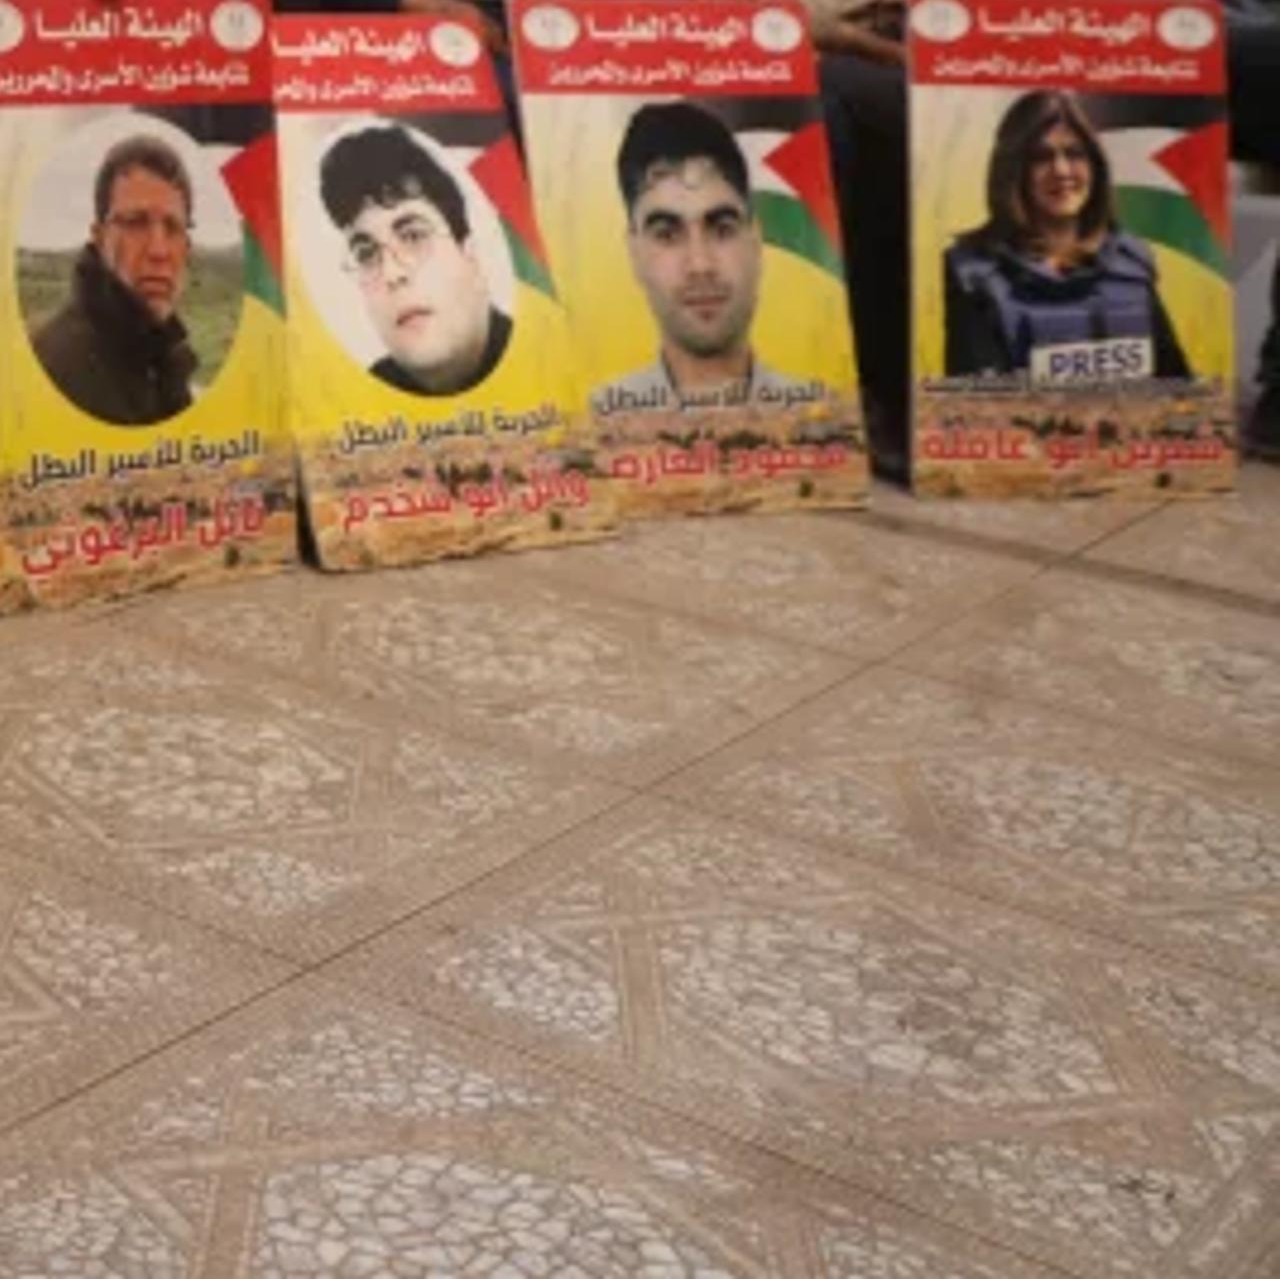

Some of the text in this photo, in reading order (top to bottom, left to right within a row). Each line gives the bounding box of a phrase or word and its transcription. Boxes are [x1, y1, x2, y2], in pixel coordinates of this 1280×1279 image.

[36, 7, 205, 49] الهيئة العليا
[269, 26, 427, 67] الهيئة العليا
[585, 11, 748, 52] الهيئة العليا
[1048, 344, 1144, 375] PRESS
[22, 429, 261, 490] الحرية للأسير البطل
[21, 501, 188, 576] البرغوثي
